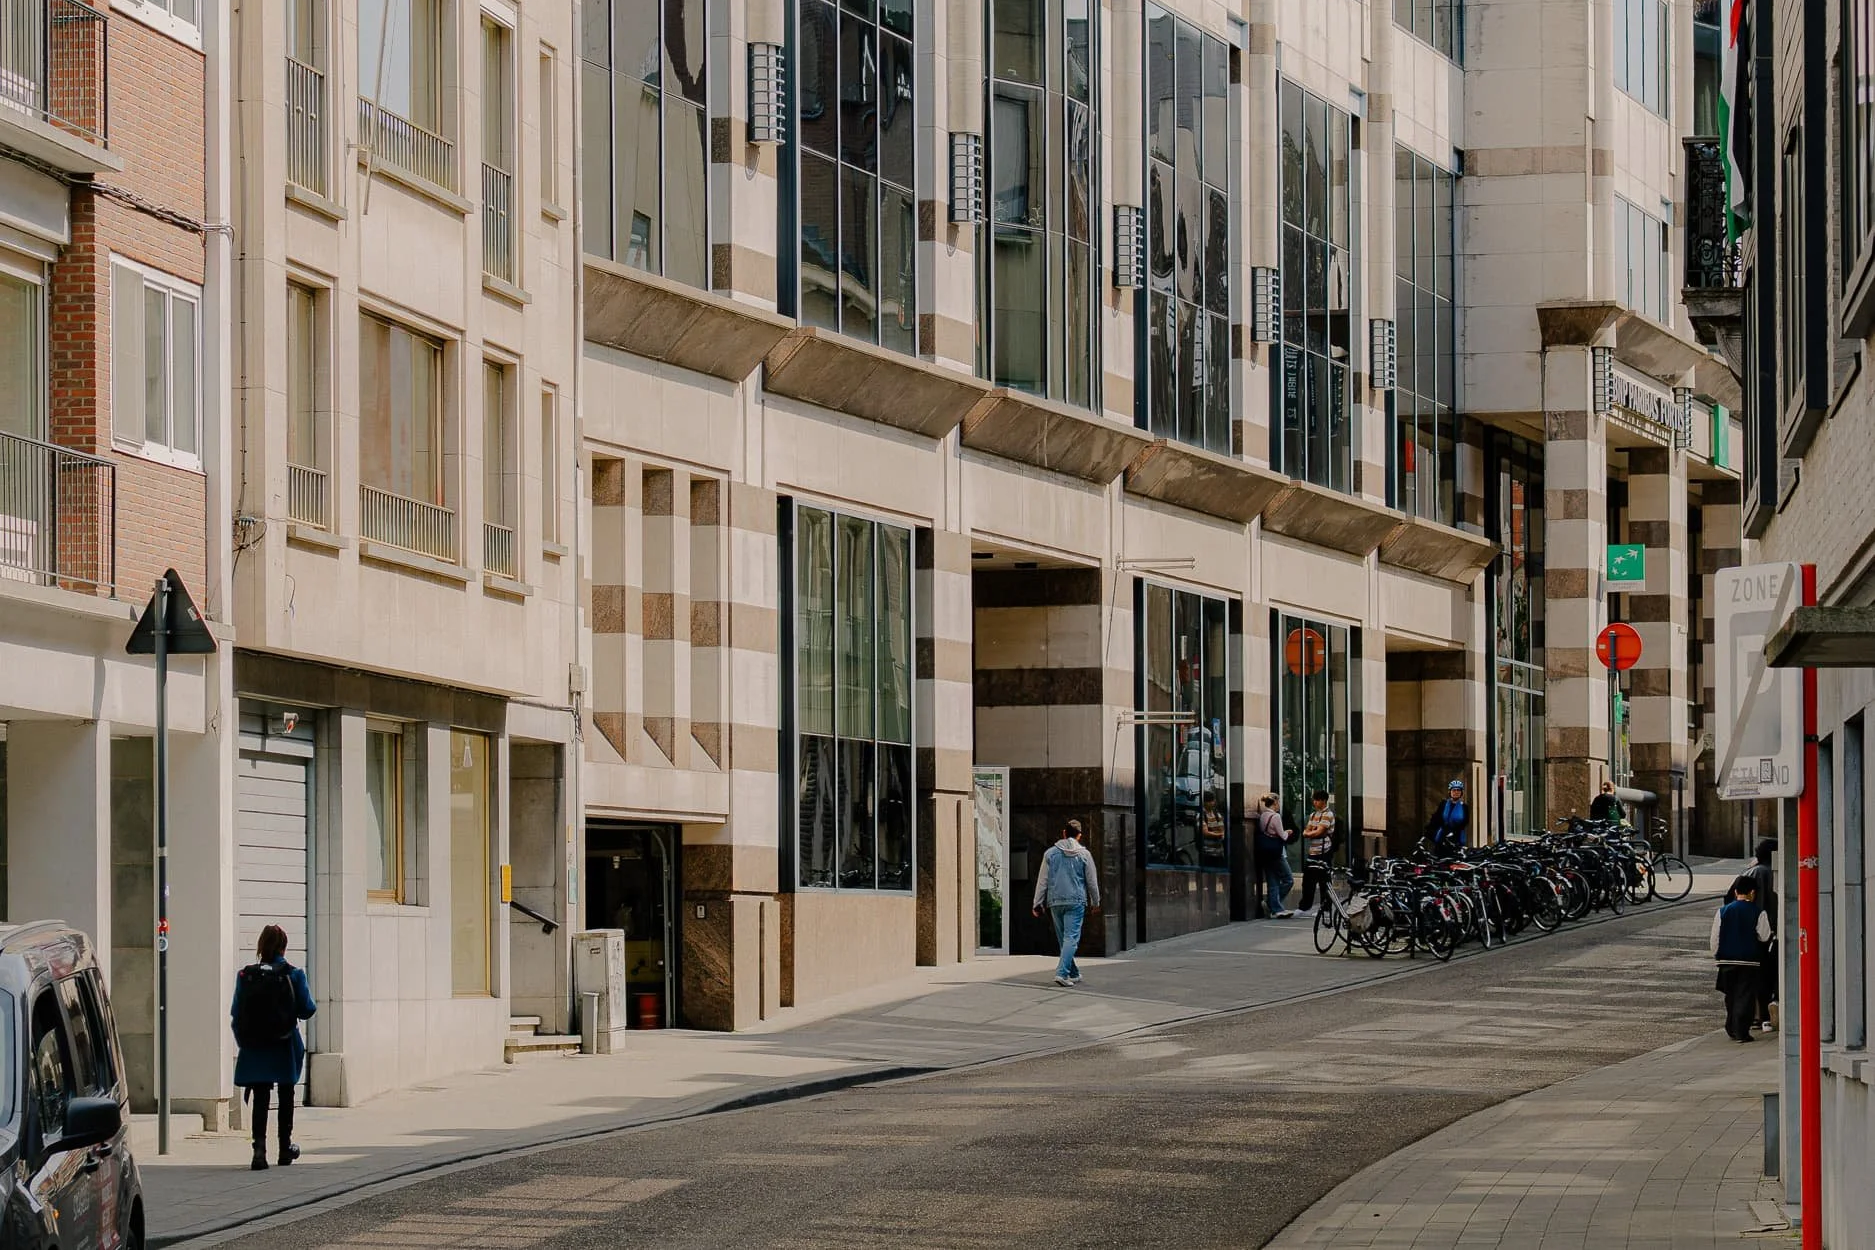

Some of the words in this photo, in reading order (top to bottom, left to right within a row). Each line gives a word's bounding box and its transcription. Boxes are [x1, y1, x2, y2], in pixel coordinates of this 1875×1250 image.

[1612, 375, 1628, 406] BNP
[1629, 384, 1659, 421] PARIBAS
[1731, 574, 1779, 602] ZONE
